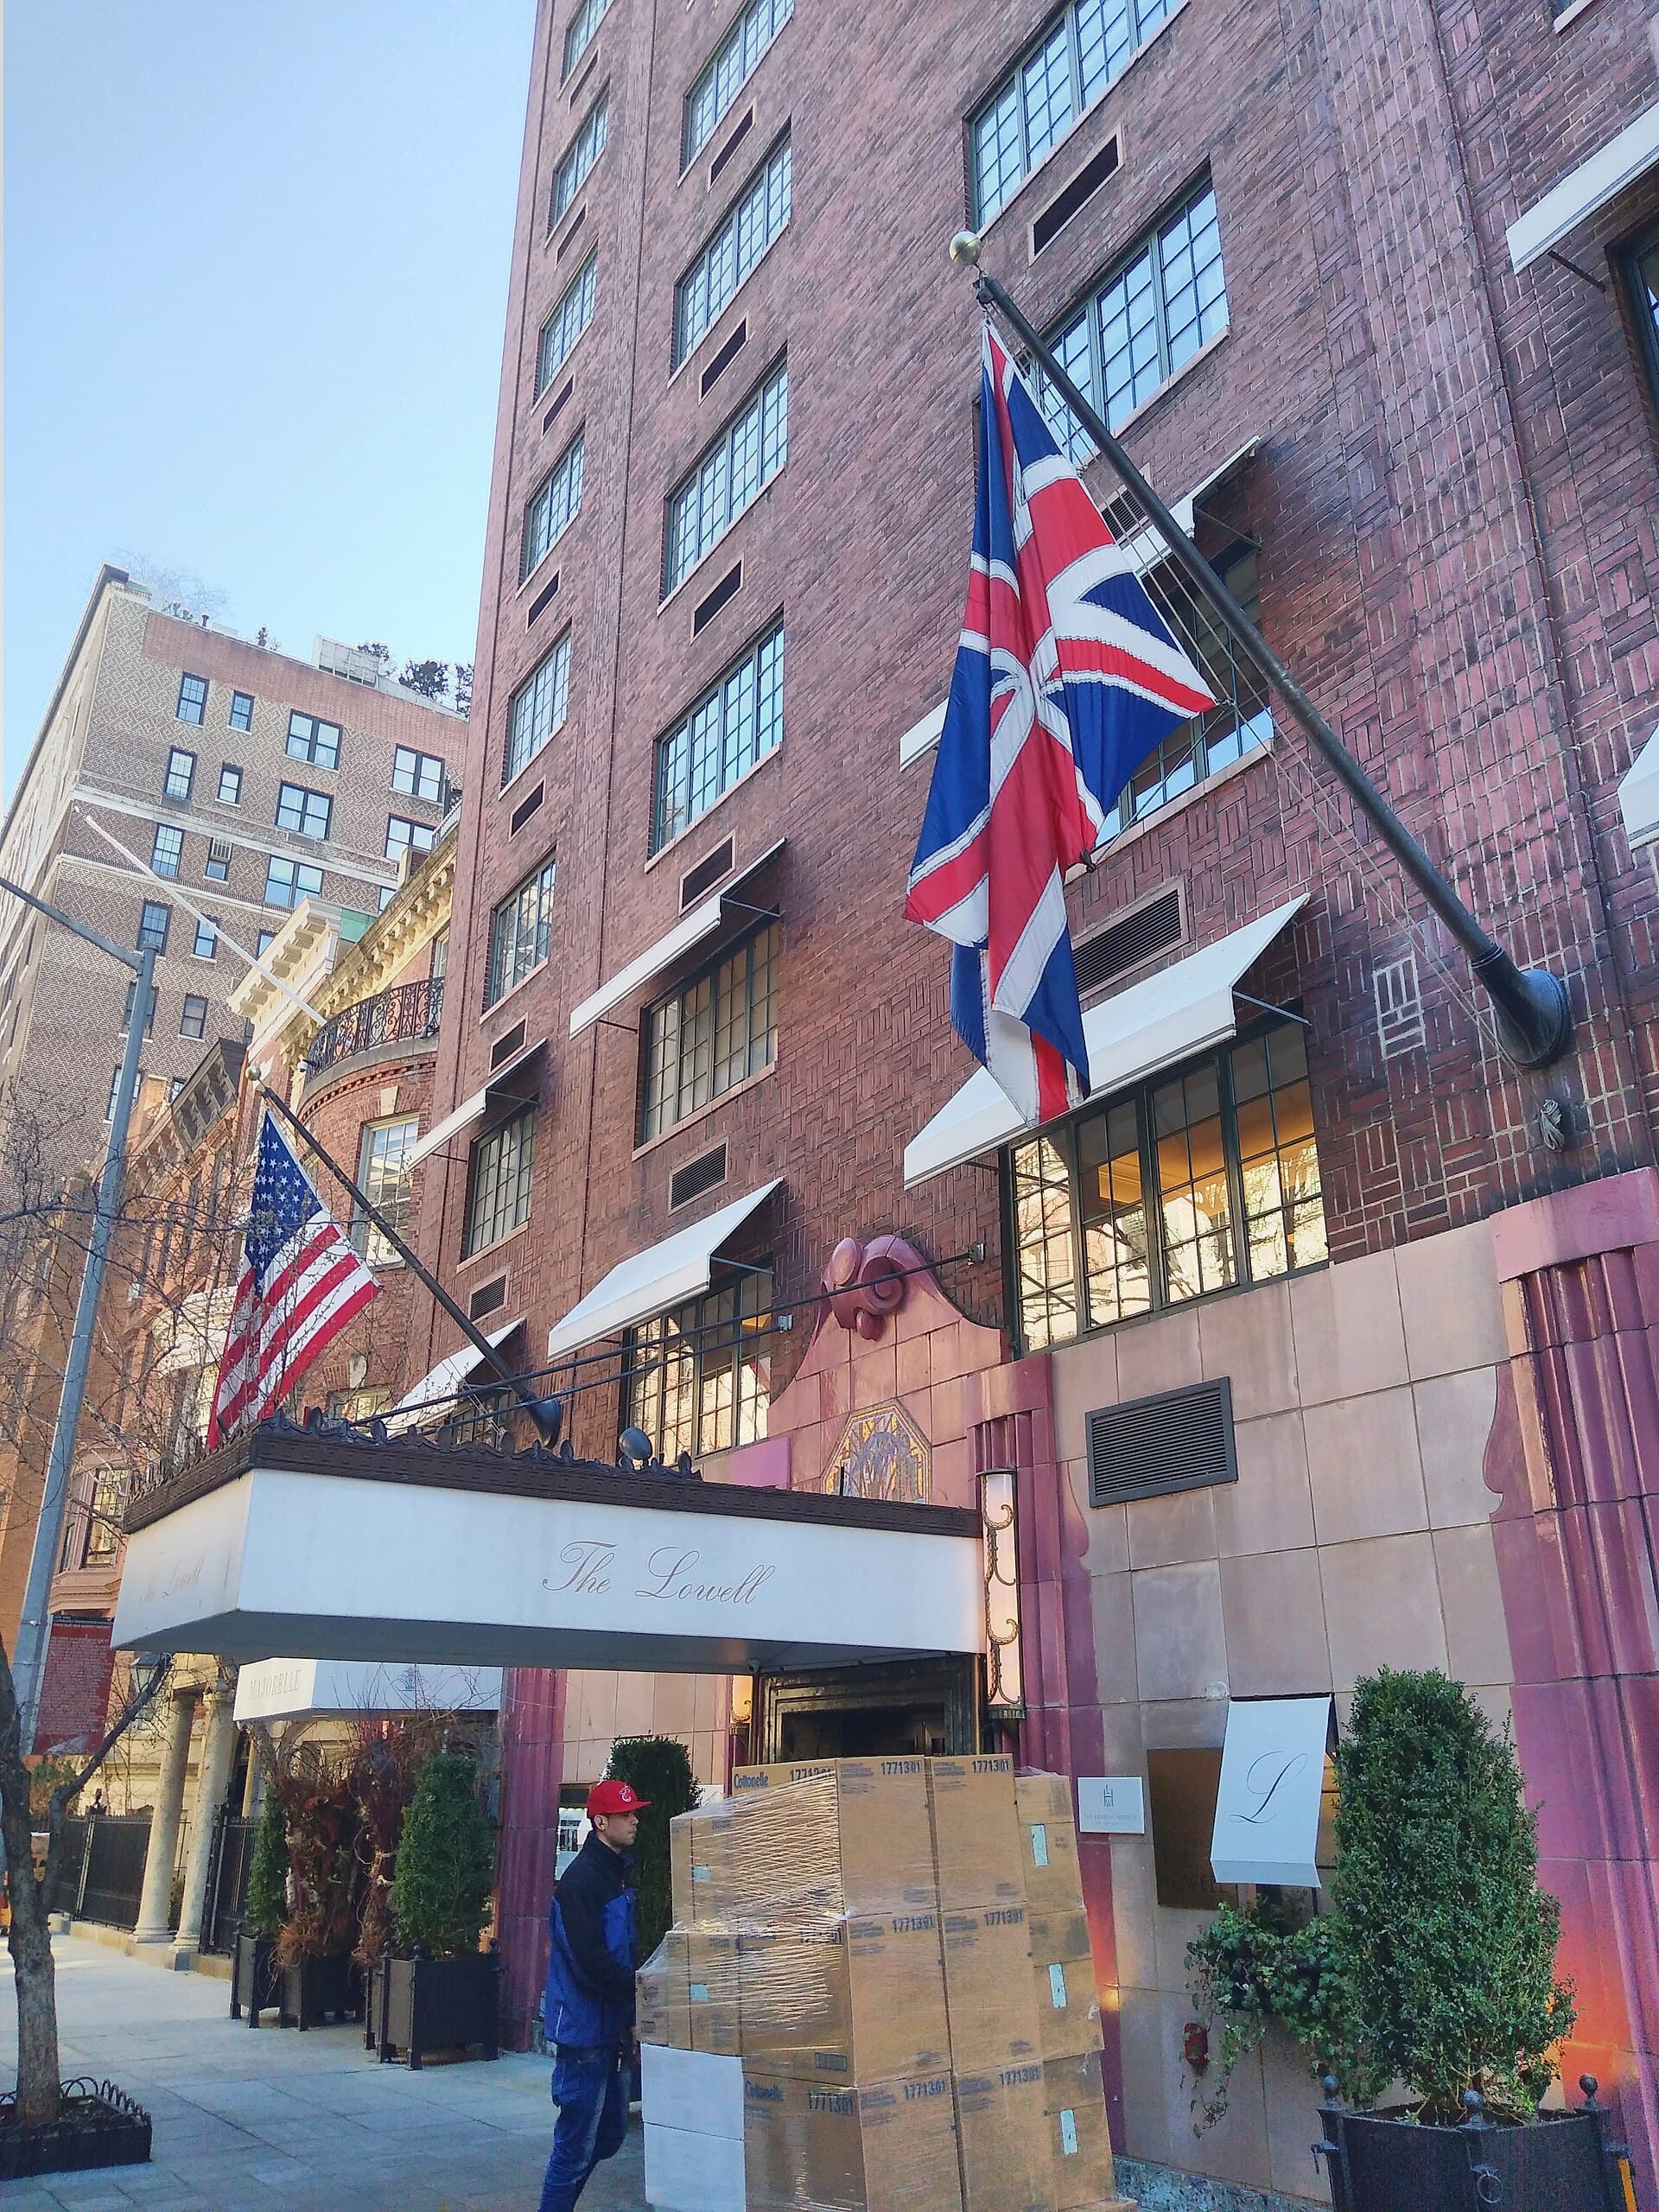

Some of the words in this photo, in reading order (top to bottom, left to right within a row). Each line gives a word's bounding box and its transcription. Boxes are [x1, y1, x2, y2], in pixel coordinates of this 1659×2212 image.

[542, 1541, 617, 1594] The
[634, 1546, 776, 1605] Lowell
[249, 1669, 302, 1700] MAJORELLE
[734, 1772, 769, 1789] Cottonelle
[1228, 1751, 1308, 1824] L
